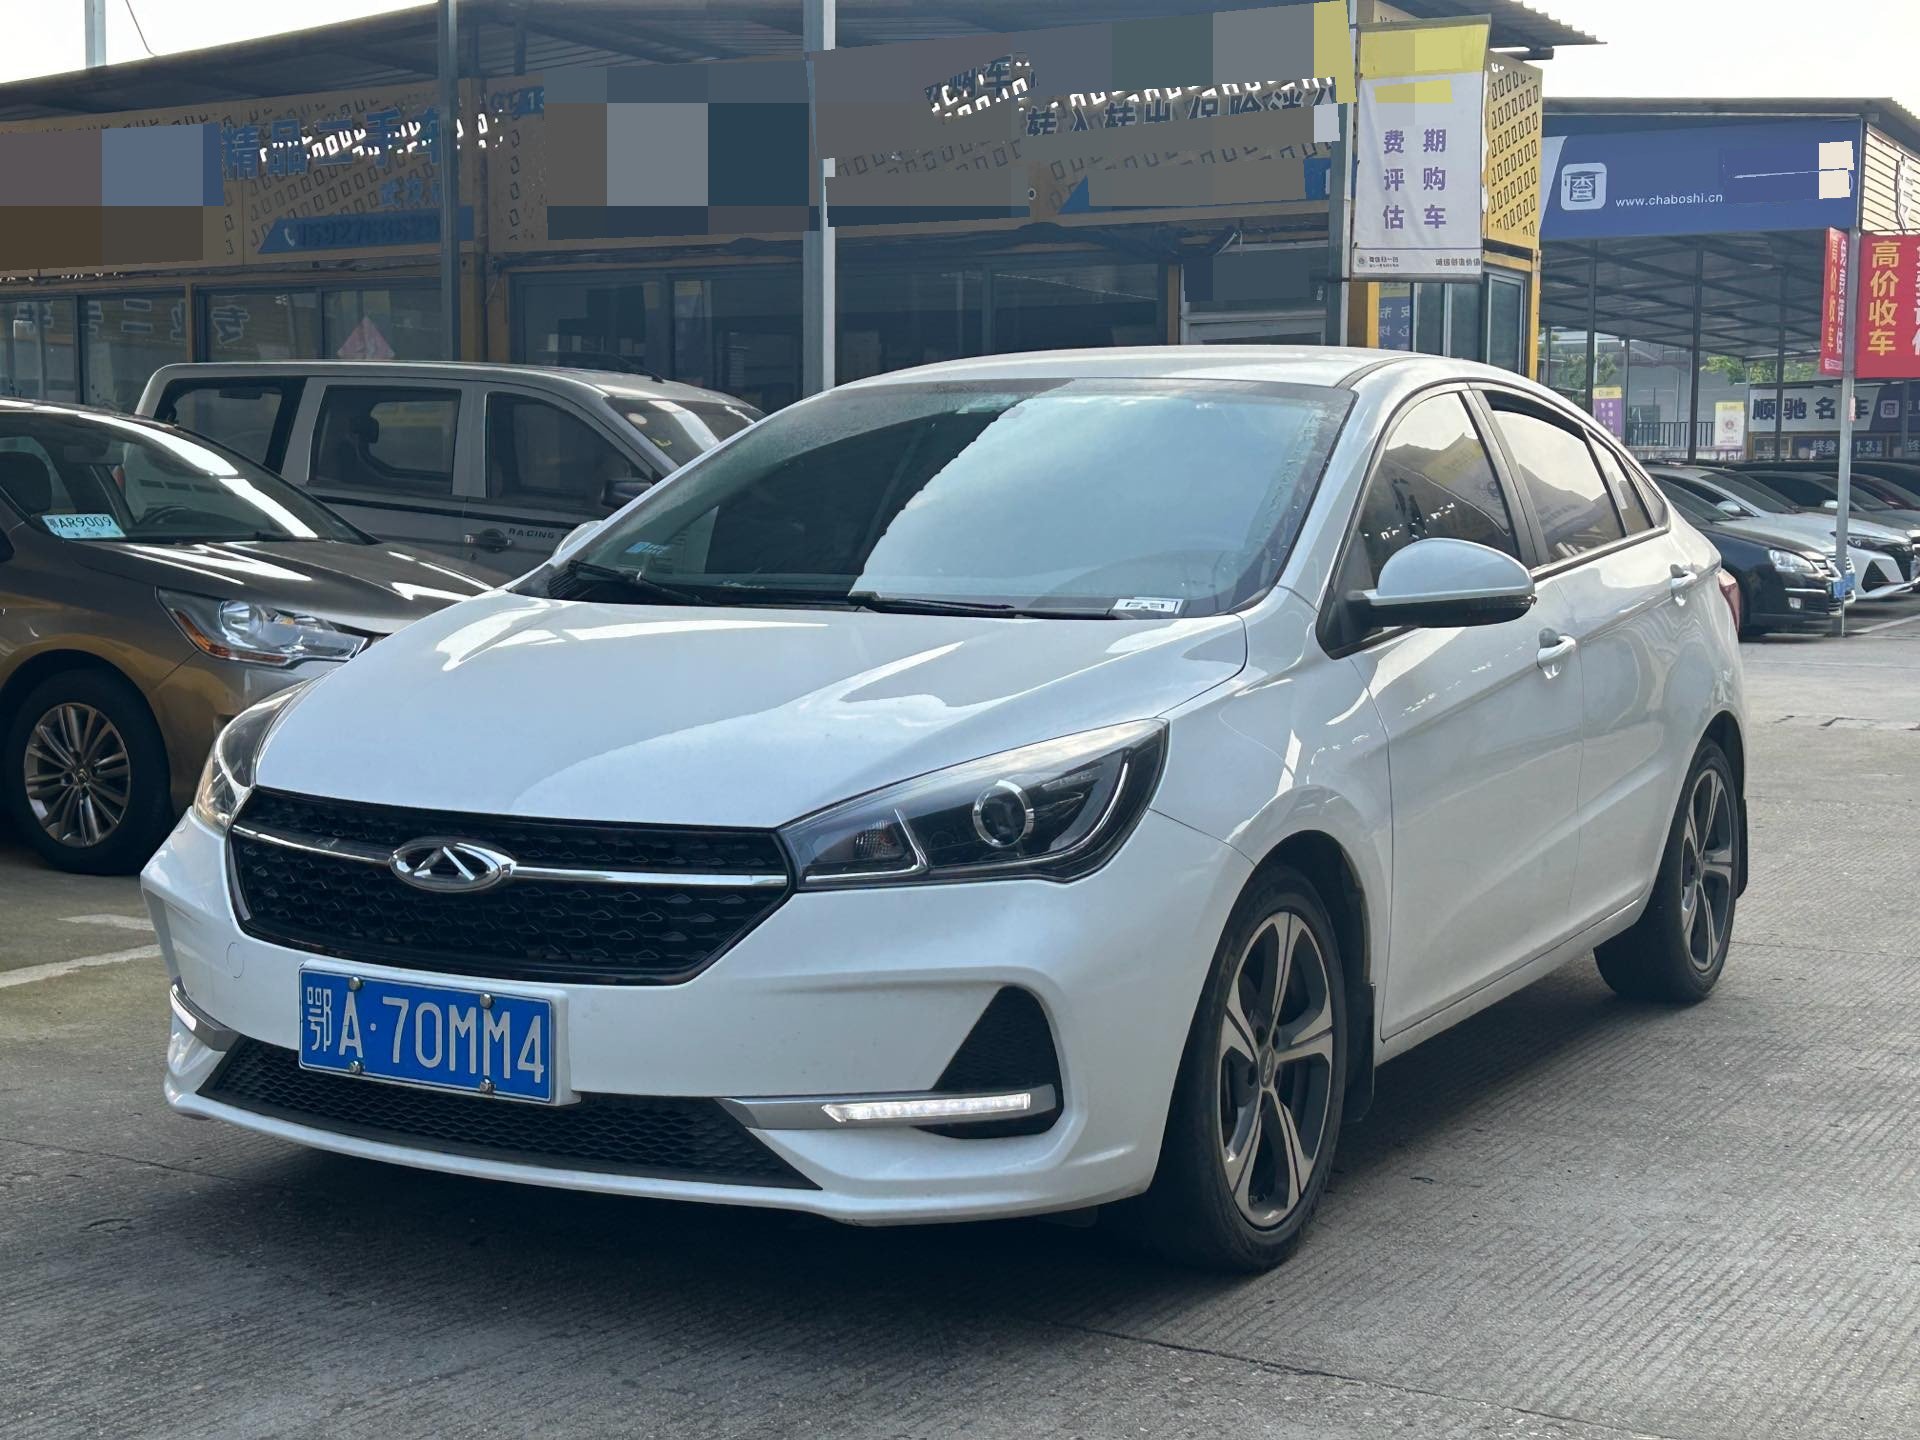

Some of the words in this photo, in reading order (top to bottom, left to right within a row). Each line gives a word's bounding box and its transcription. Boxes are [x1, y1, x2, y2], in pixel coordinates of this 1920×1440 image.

[1616, 193, 1723, 208] www.chaboshi.cn
[1867, 240, 1901, 356] 高价收车
[508, 527, 555, 540] RACING
[306, 986, 545, 1083] 鄂A·70MM4
